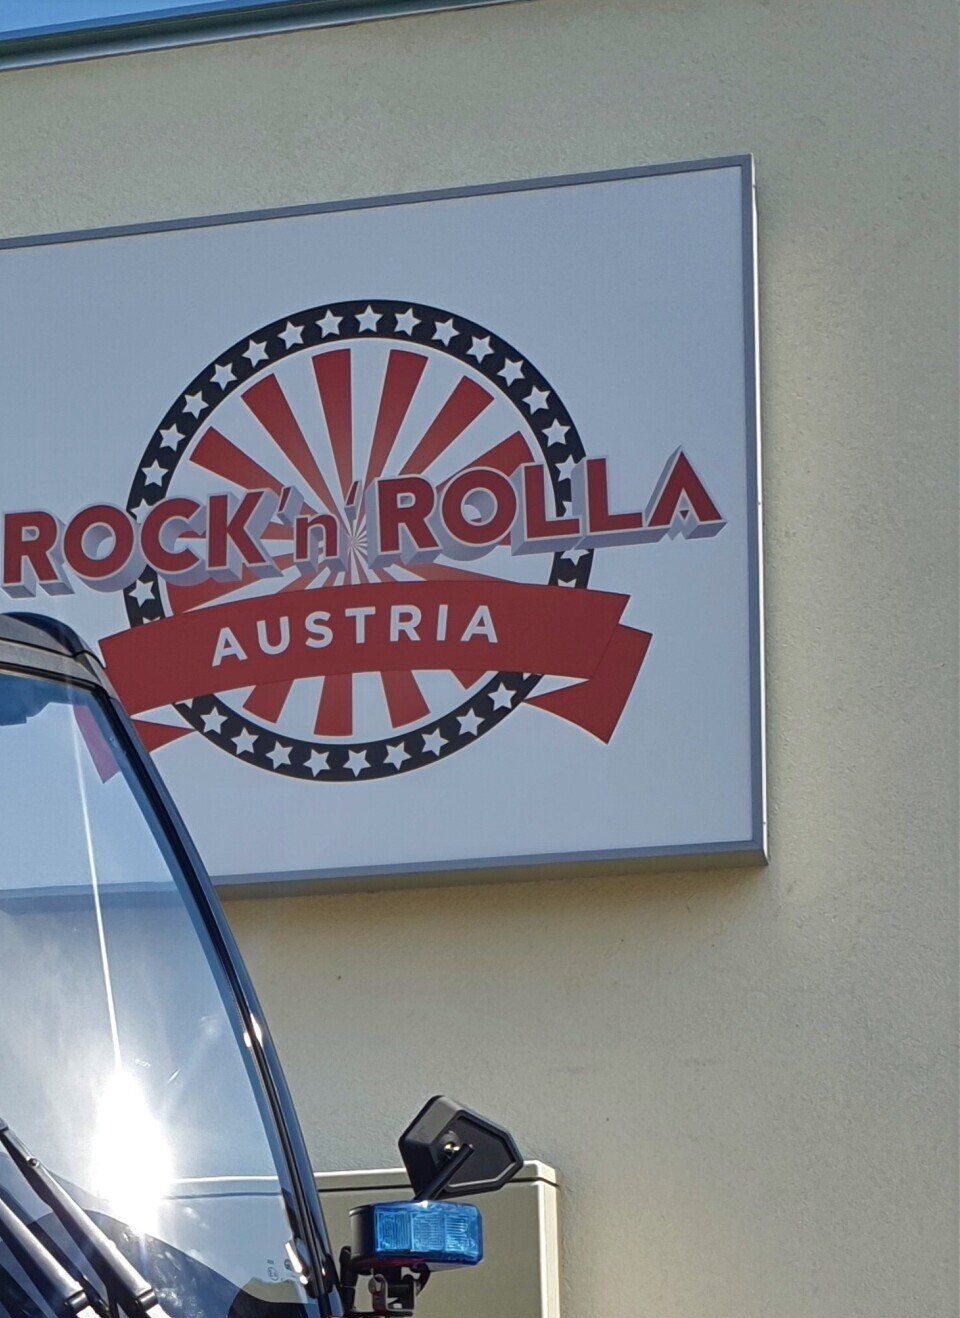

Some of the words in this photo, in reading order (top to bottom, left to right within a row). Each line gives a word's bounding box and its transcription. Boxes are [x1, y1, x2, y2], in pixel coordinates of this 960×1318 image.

[2, 487, 274, 594] ROCK
[370, 447, 725, 562] ROLLA
[211, 604, 498, 667] AUSTRIA
